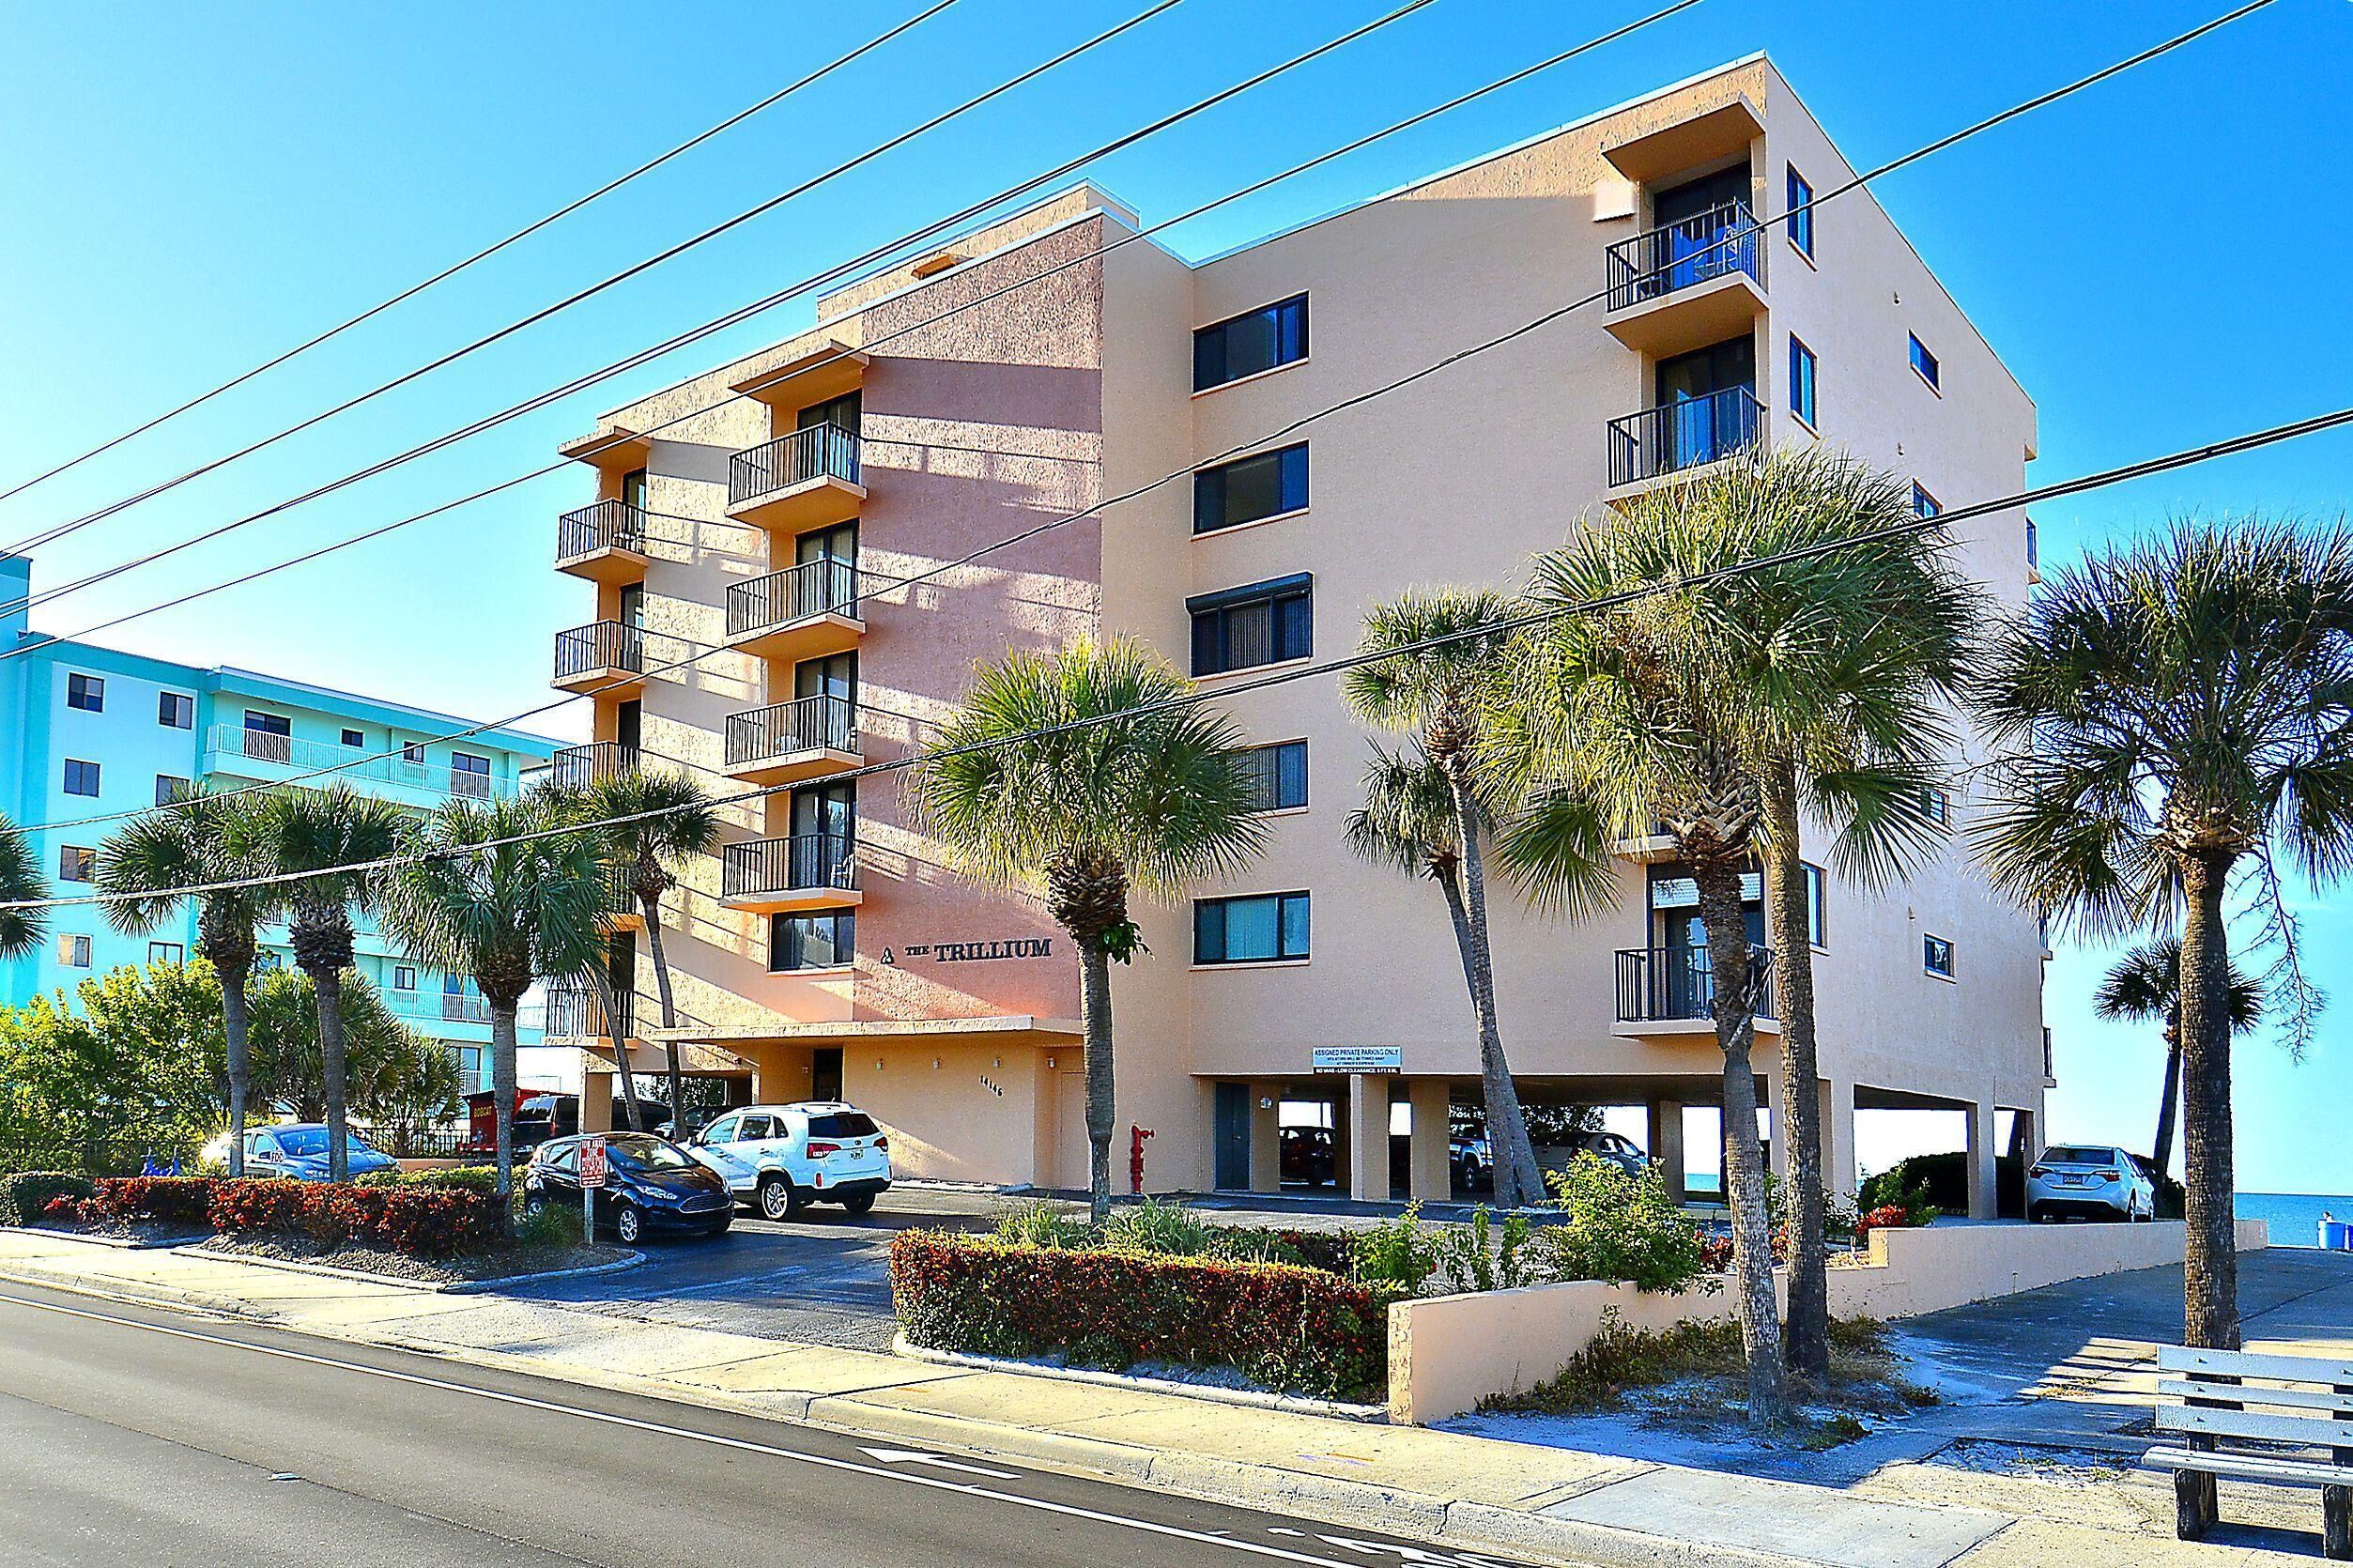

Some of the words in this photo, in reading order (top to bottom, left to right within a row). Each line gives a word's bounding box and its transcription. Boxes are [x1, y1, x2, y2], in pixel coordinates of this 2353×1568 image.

[904, 945, 930, 956] THE
[933, 938, 1053, 962] TRILLIUM
[979, 1074, 1004, 1097] 14146
[473, 1106, 492, 1118] BOBCAT
[592, 1140, 603, 1148] AWAY
